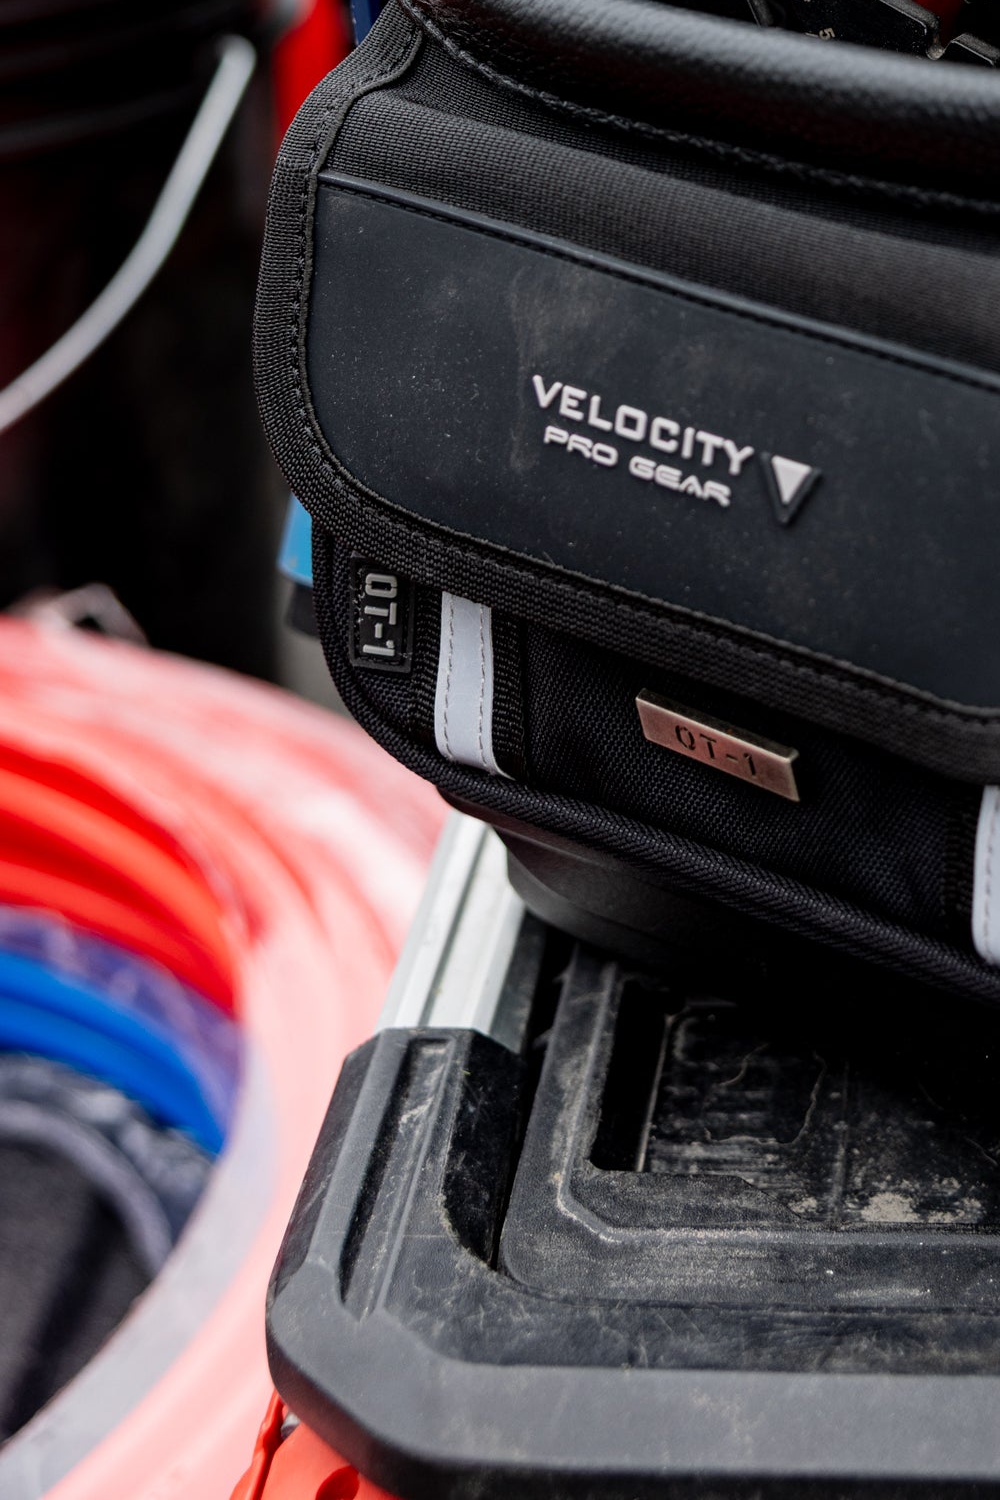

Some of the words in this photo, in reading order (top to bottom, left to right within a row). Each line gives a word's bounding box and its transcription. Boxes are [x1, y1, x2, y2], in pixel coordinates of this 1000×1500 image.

[819, 27, 835, 40] 5
[532, 374, 754, 476] VELOCITY
[543, 425, 618, 467] PRO
[629, 455, 731, 507] GEAR
[362, 573, 398, 657] OT-1
